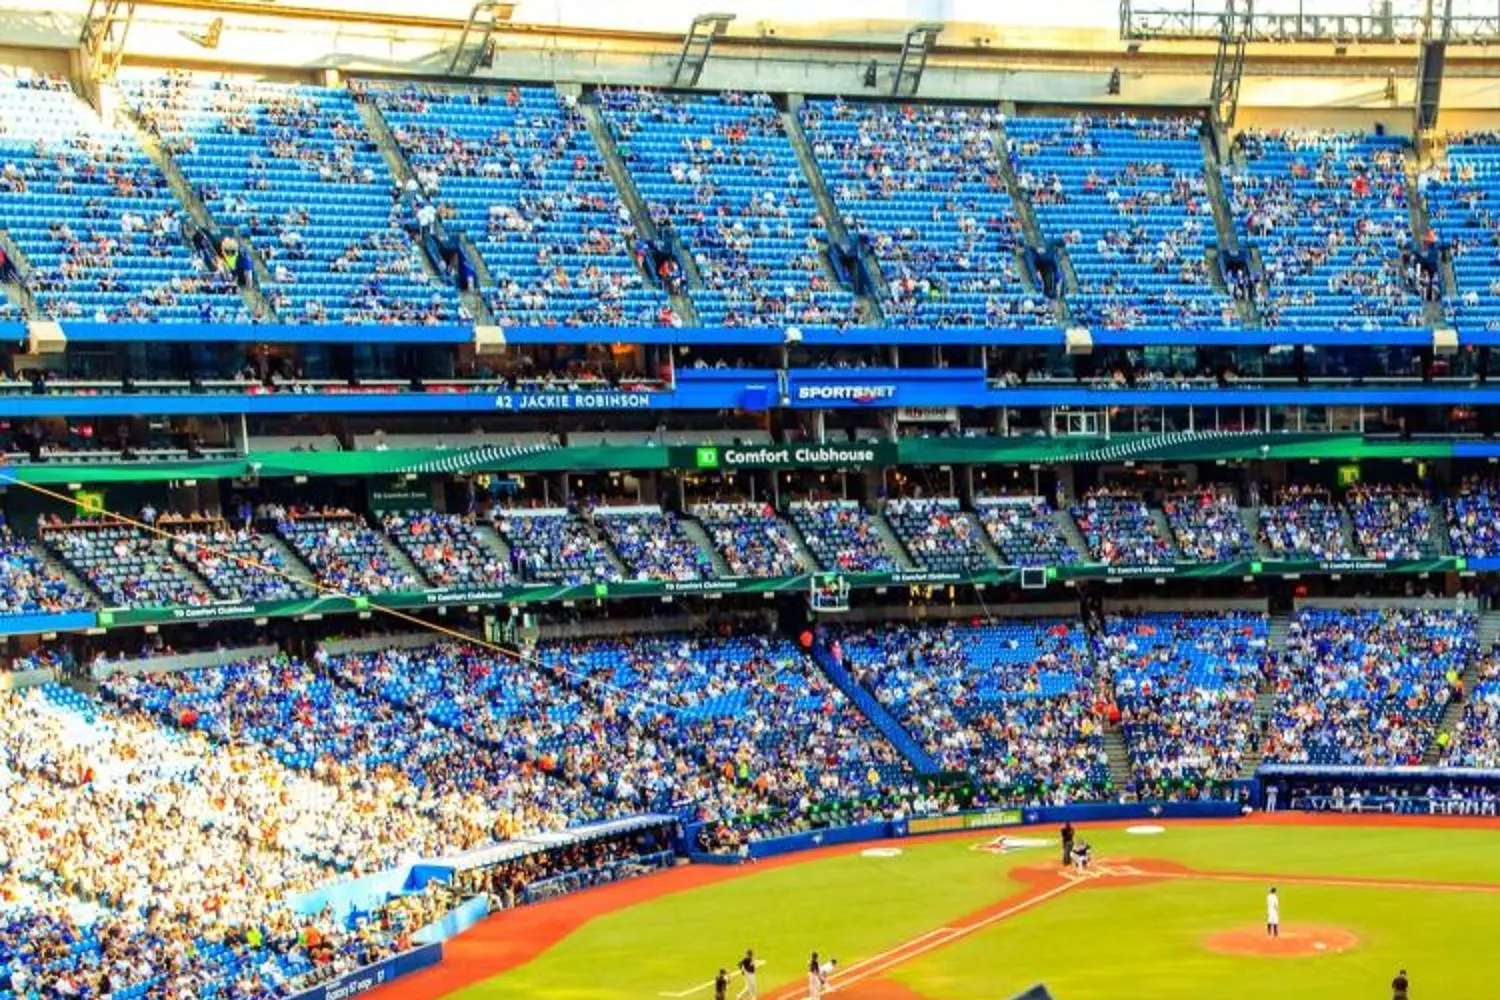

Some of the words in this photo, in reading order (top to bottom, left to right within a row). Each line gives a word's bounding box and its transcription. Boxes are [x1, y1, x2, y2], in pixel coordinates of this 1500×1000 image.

[800, 386, 895, 399] SPORTSNET
[495, 394, 513, 409] 42
[520, 394, 569, 409] JACKIE
[575, 394, 650, 409] ROBINSON
[725, 449, 789, 464] Comfort
[795, 449, 873, 462] Clubhouse
